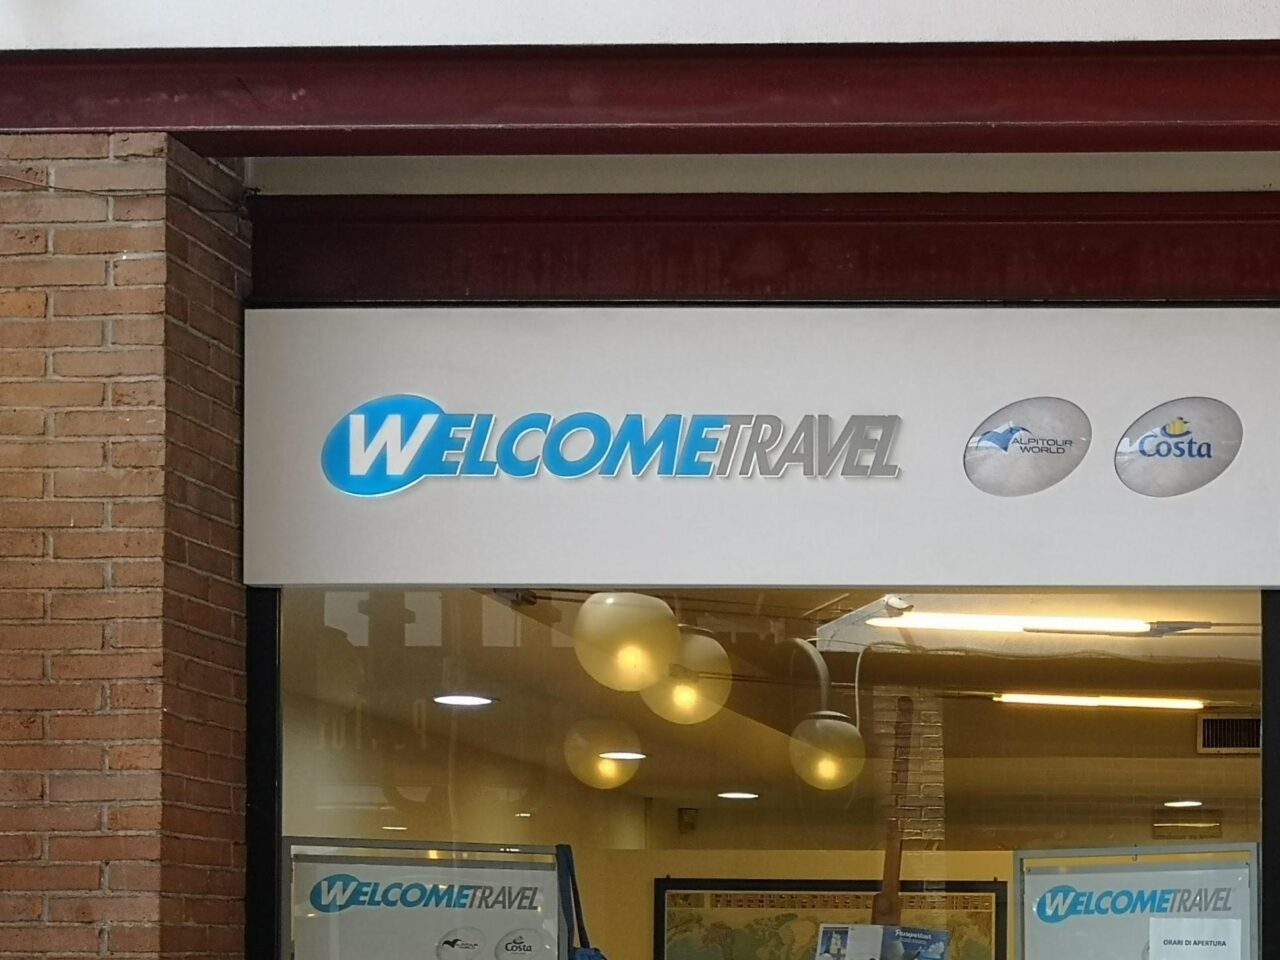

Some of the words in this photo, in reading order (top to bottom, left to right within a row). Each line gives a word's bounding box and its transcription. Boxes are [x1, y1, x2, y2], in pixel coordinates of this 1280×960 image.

[340, 410, 903, 480] WELCOMETRAVEL
[1011, 437, 1073, 448] ALPITOUR
[1019, 445, 1066, 455] WORLD
[1138, 432, 1213, 461] Costa
[317, 878, 540, 912] WELCOMETRAVEL
[1040, 886, 1233, 918] WELCOMETRAVEL
[505, 941, 532, 952] Costa
